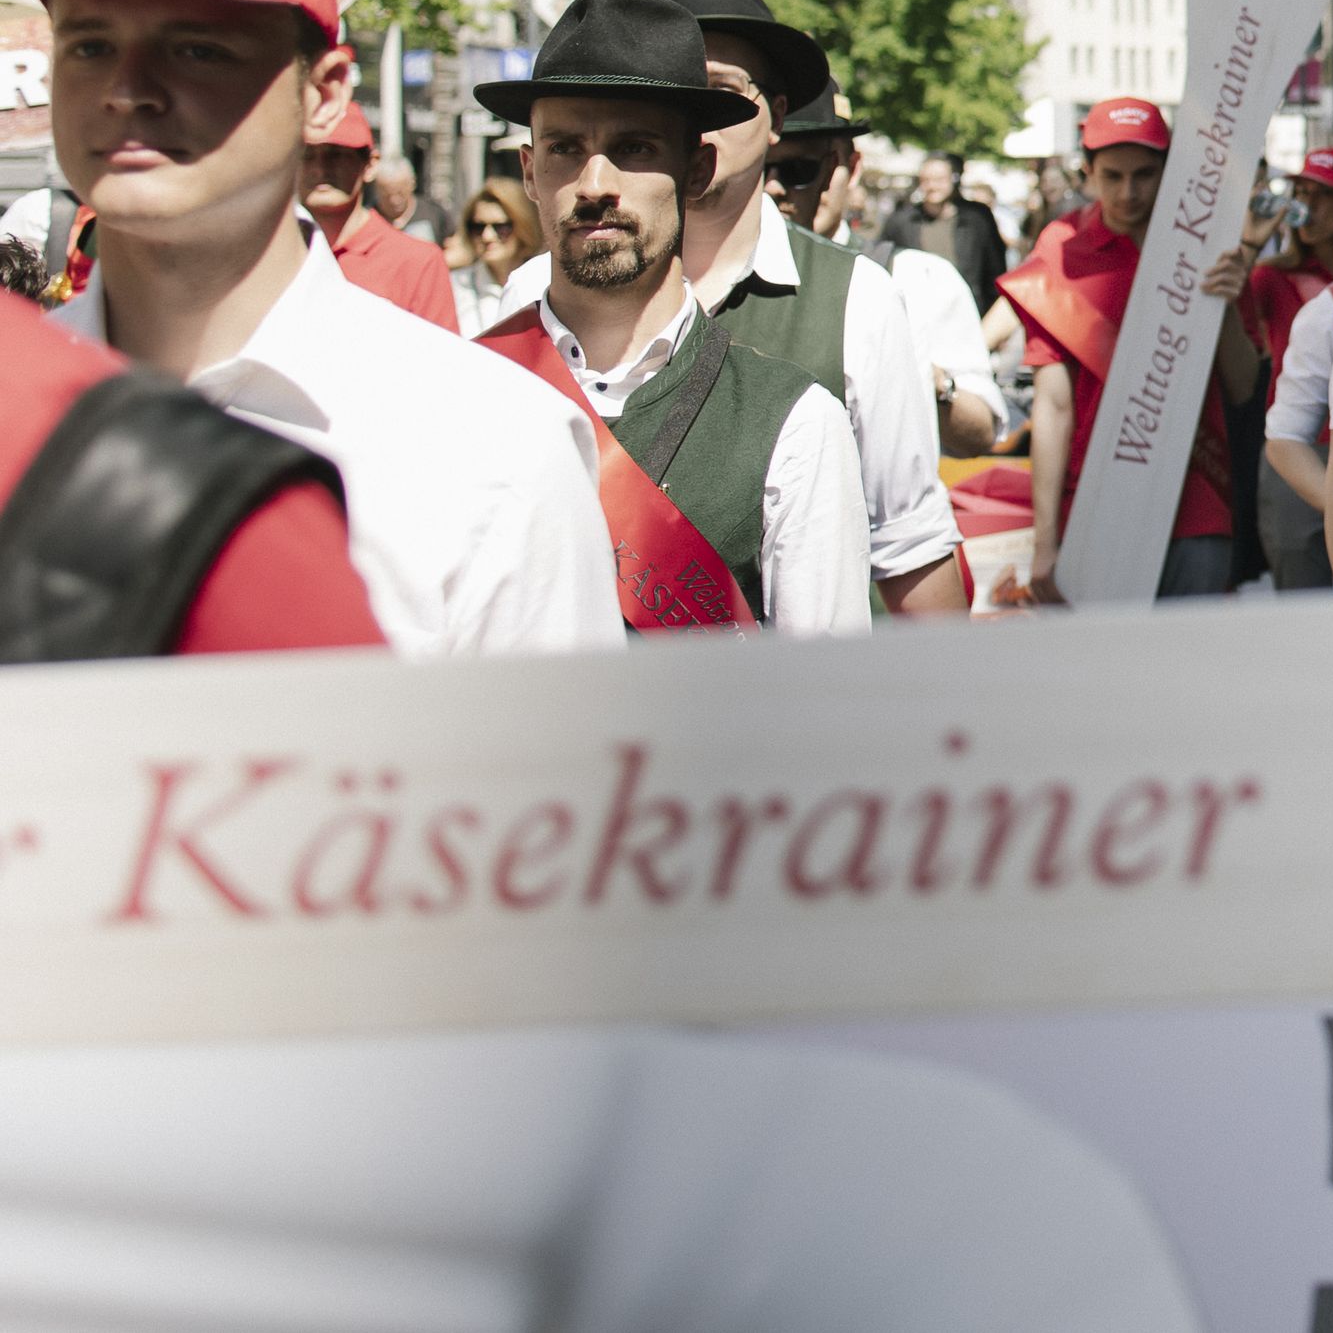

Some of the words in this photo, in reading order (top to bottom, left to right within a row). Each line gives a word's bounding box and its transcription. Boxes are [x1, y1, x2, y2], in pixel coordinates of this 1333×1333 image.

[1173, 5, 1263, 244] Käsekrainer
[1156, 252, 1199, 317] der
[1112, 326, 1190, 468] Welttag
[102, 726, 1264, 928] Käsekrainer
